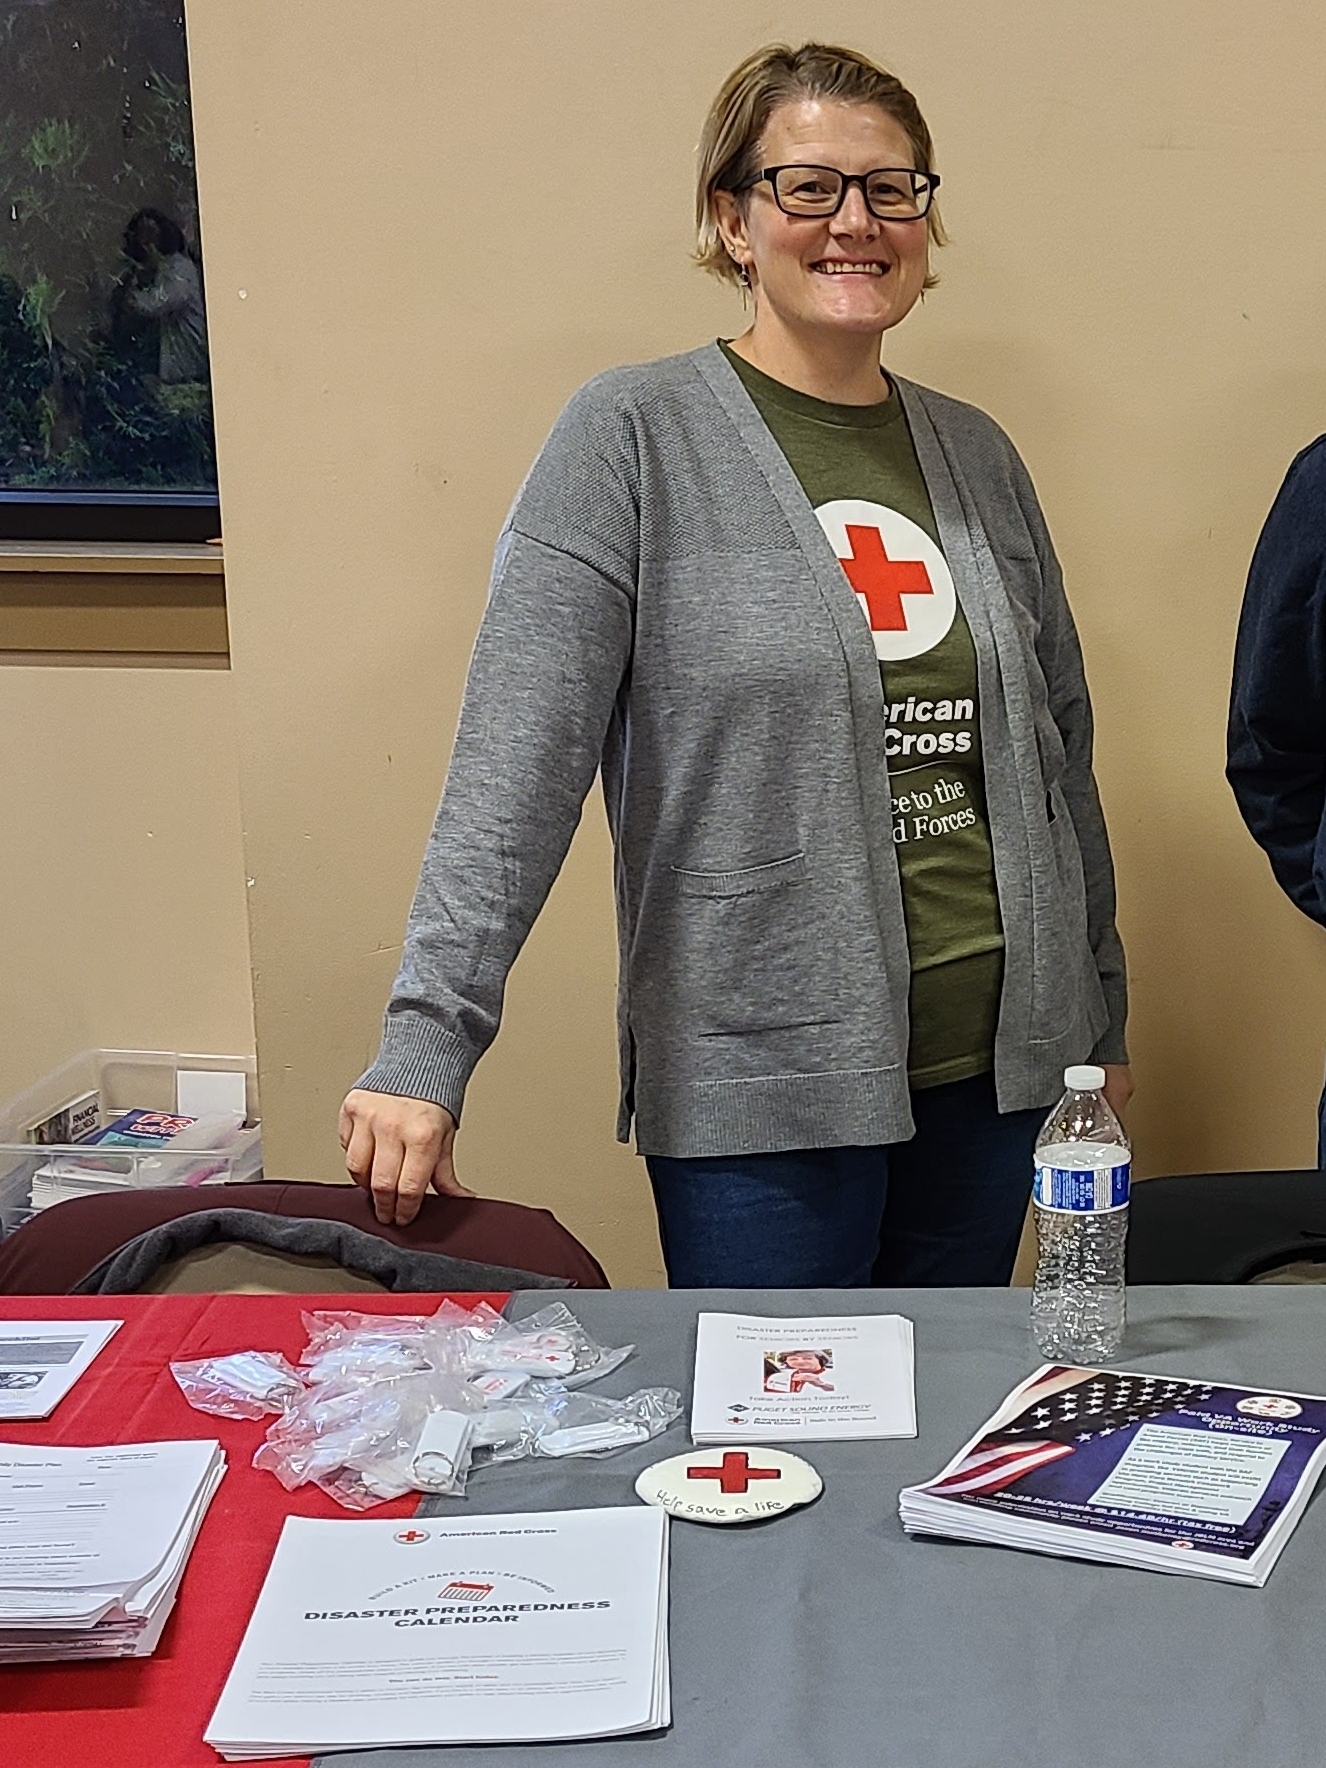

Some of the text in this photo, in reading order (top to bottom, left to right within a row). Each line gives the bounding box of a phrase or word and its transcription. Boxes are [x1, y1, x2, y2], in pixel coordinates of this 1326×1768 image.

[883, 696, 974, 722] rican
[884, 728, 972, 756] Cross
[910, 791, 933, 809] to
[934, 778, 966, 804] the
[912, 807, 976, 840] Forces
[656, 1489, 683, 1511] Help
[685, 1504, 727, 1517] save
[754, 1502, 785, 1511] life
[303, 1600, 611, 1620] DISASTER PREPAREDNESS
[394, 1615, 520, 1628] CALENDAR
